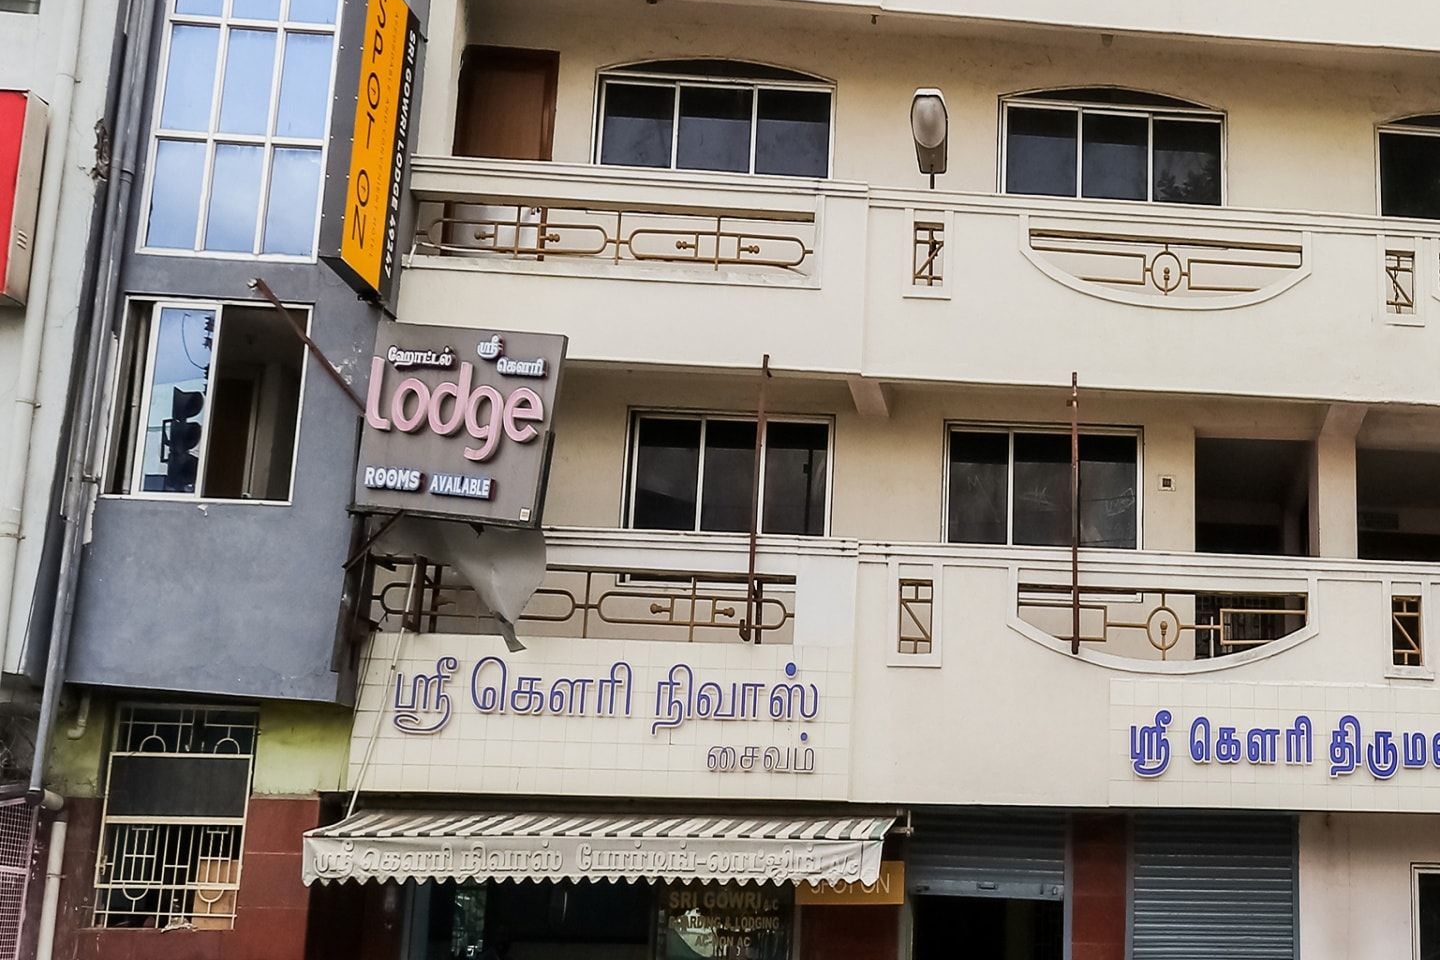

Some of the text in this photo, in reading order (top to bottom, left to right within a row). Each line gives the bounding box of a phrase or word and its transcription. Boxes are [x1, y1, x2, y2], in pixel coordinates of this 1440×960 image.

[384, 30, 416, 279] SRI GOWRI LODGE 49247
[365, 467, 490, 499] ROOMS AVAILABLE
[706, 731, 816, 774] சைவம்
[669, 891, 698, 909] SRI
[703, 891, 761, 909] GOWRI
[734, 916, 780, 929] LODGING
